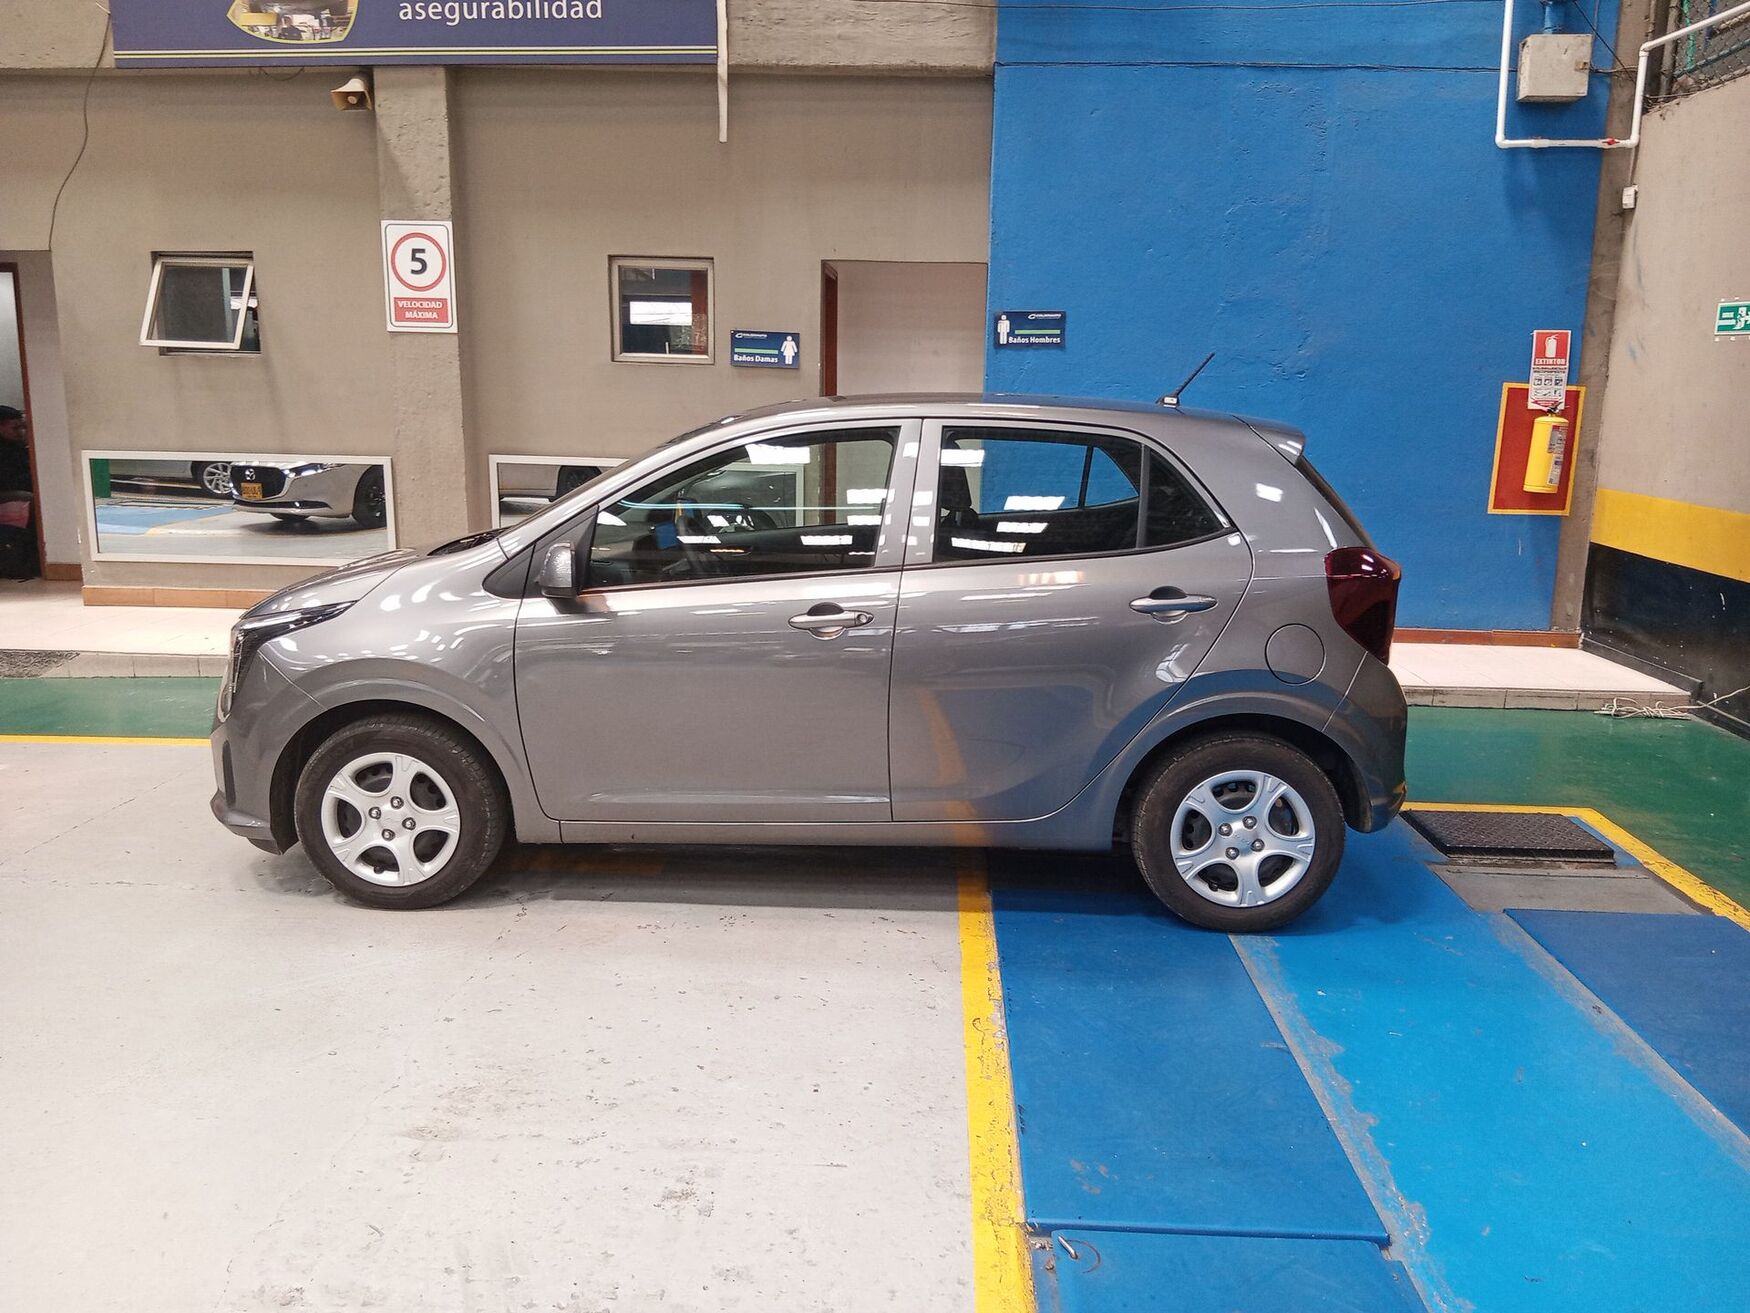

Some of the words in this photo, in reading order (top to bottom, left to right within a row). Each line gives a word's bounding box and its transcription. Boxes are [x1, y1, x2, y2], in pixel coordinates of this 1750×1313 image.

[399, 0, 603, 26] asegurabilidad
[410, 248, 428, 275] 5
[398, 301, 443, 309] VELOCIDAD
[405, 310, 438, 319] MÁXIMA
[1008, 336, 1029, 344] Baños
[1030, 336, 1061, 344] Hombres
[733, 354, 754, 362] Baños
[755, 355, 778, 363] Damas
